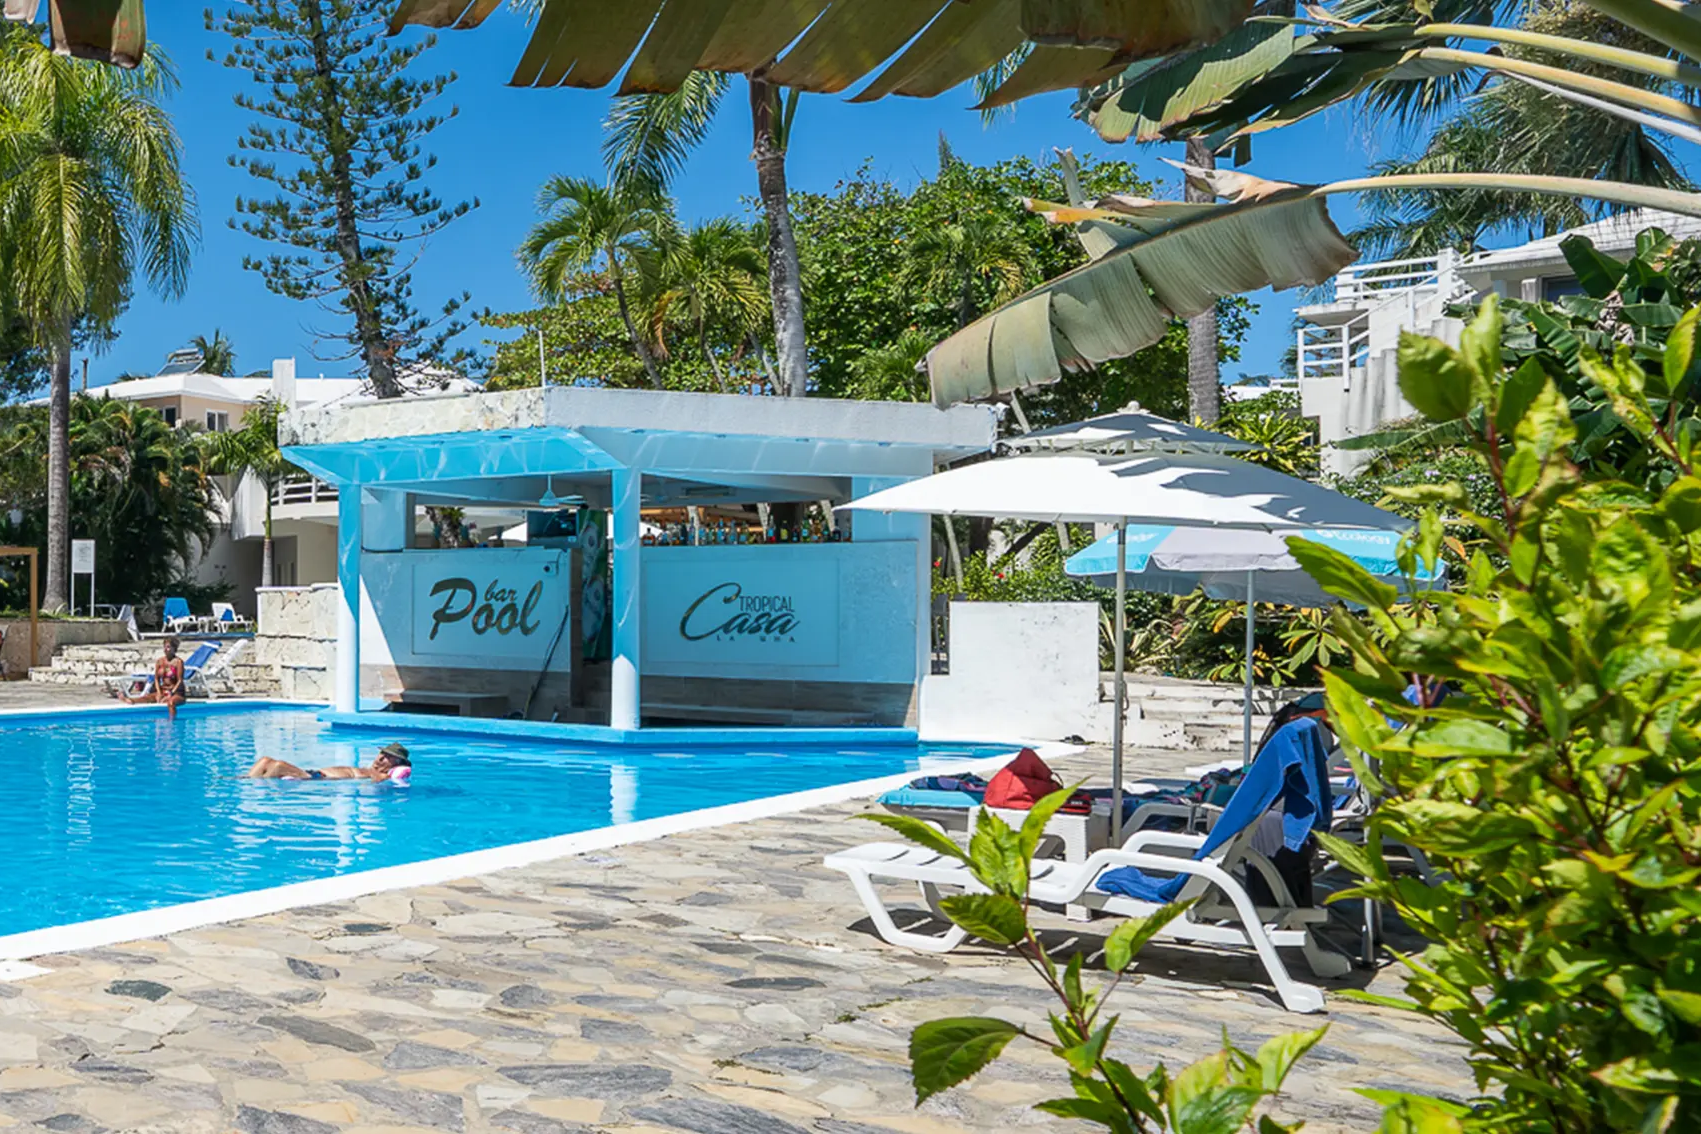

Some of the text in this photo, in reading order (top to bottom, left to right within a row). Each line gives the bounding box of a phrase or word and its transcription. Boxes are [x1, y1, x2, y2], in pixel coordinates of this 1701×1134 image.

[429, 577, 543, 641] Pool
[484, 579, 518, 602] bar
[738, 595, 795, 613] TROPICAL
[680, 582, 801, 641] Casa
